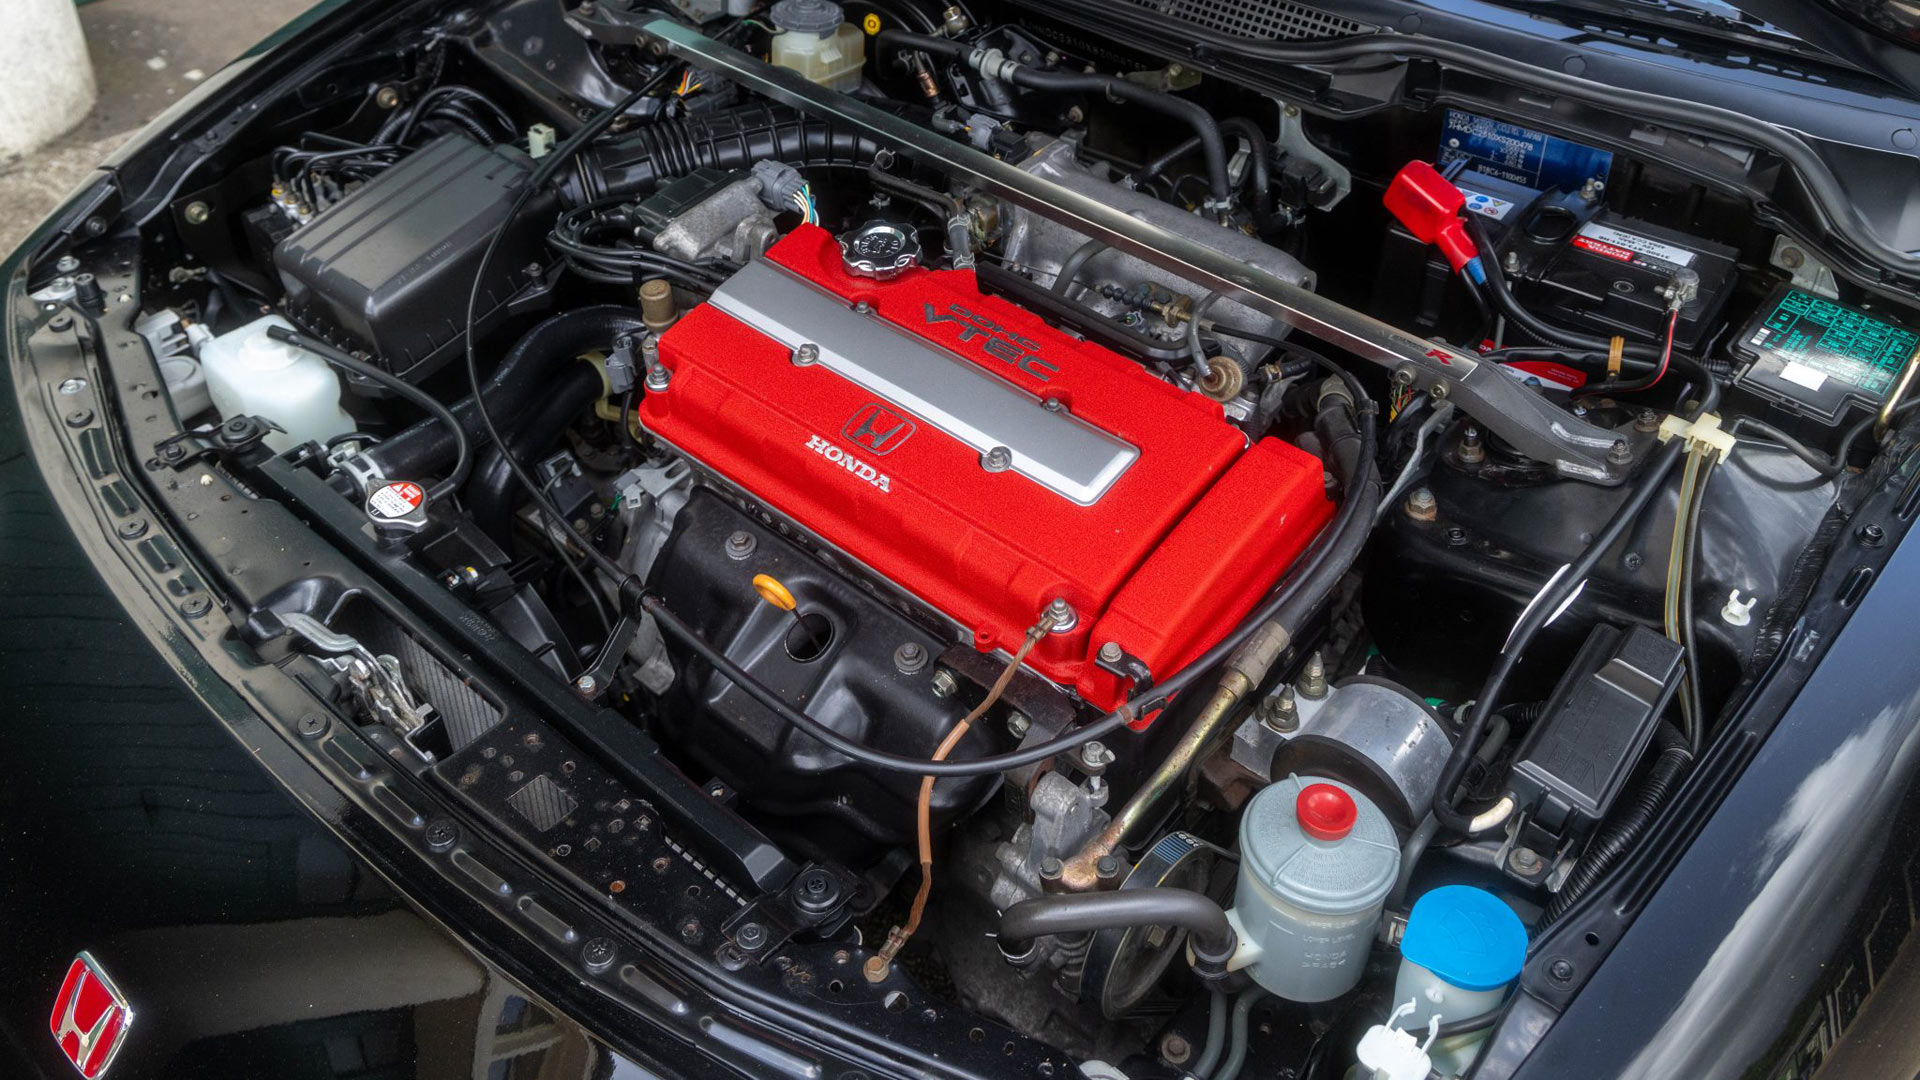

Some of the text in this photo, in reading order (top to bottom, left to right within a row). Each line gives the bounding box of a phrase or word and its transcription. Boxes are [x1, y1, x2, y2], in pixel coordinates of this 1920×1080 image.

[923, 302, 1059, 382] VTEC
[948, 303, 1041, 351] DOHC
[804, 434, 891, 494] HONDA
